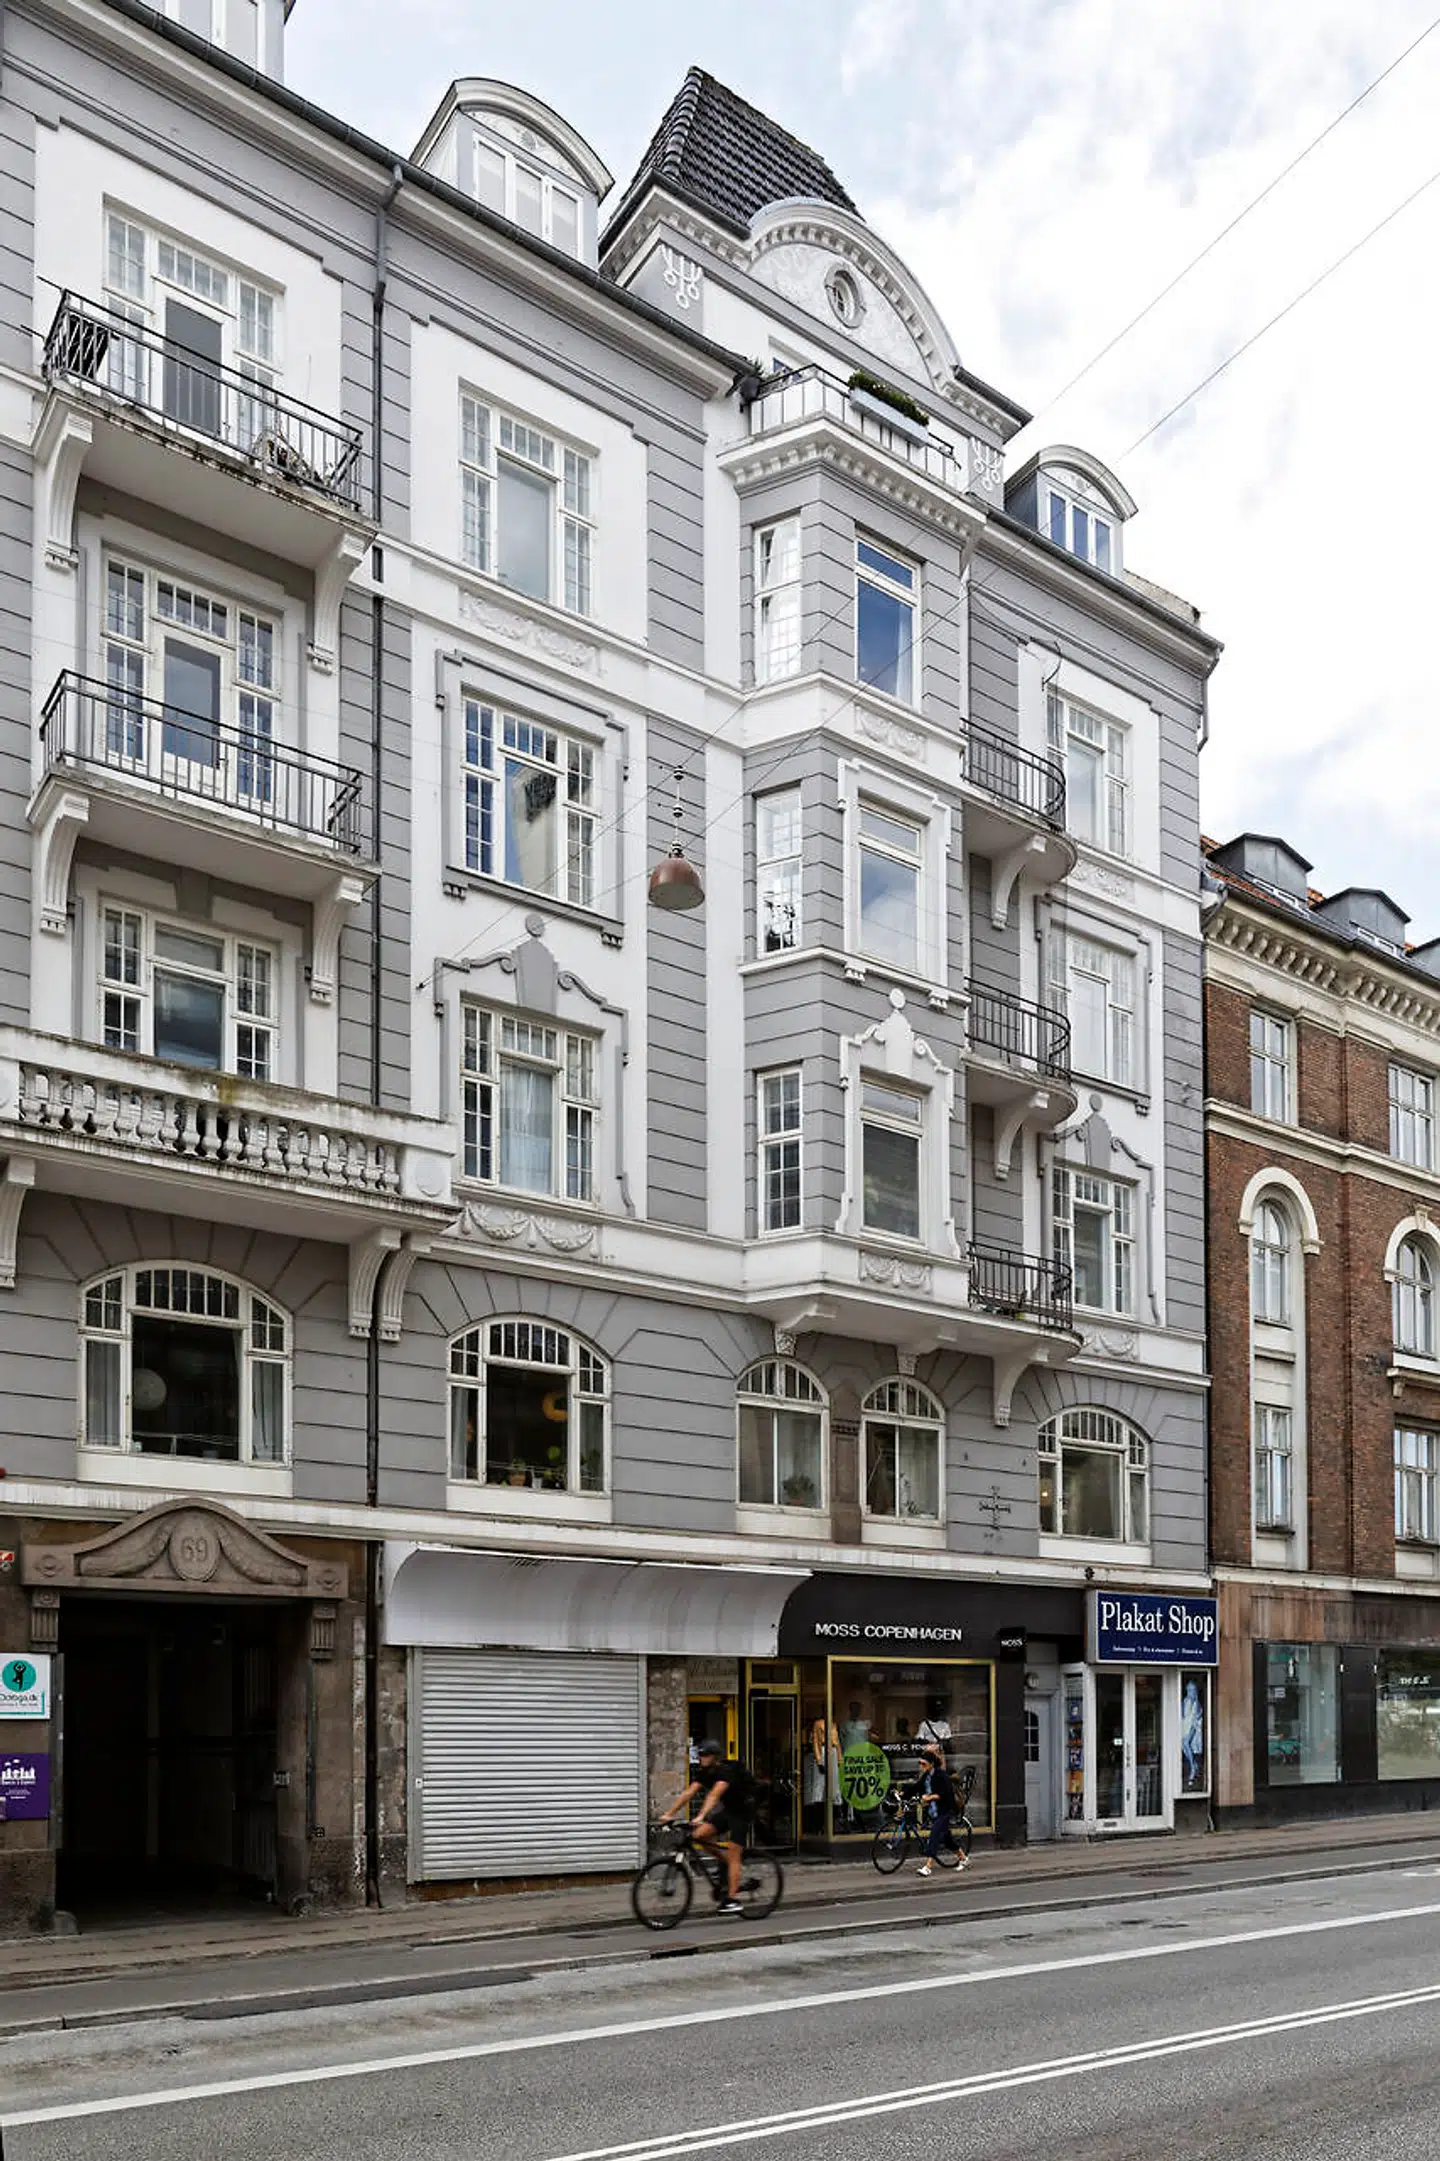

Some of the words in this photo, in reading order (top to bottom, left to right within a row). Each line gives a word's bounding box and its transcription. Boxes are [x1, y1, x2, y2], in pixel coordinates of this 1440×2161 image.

[181, 1536, 209, 1561] 69
[814, 1622, 861, 1638] MOSS
[864, 1624, 963, 1642] COPENHAGEN
[1100, 1600, 1165, 1633] Plakat
[1168, 1604, 1215, 1642] Shop
[844, 1776, 884, 1800] 70%
